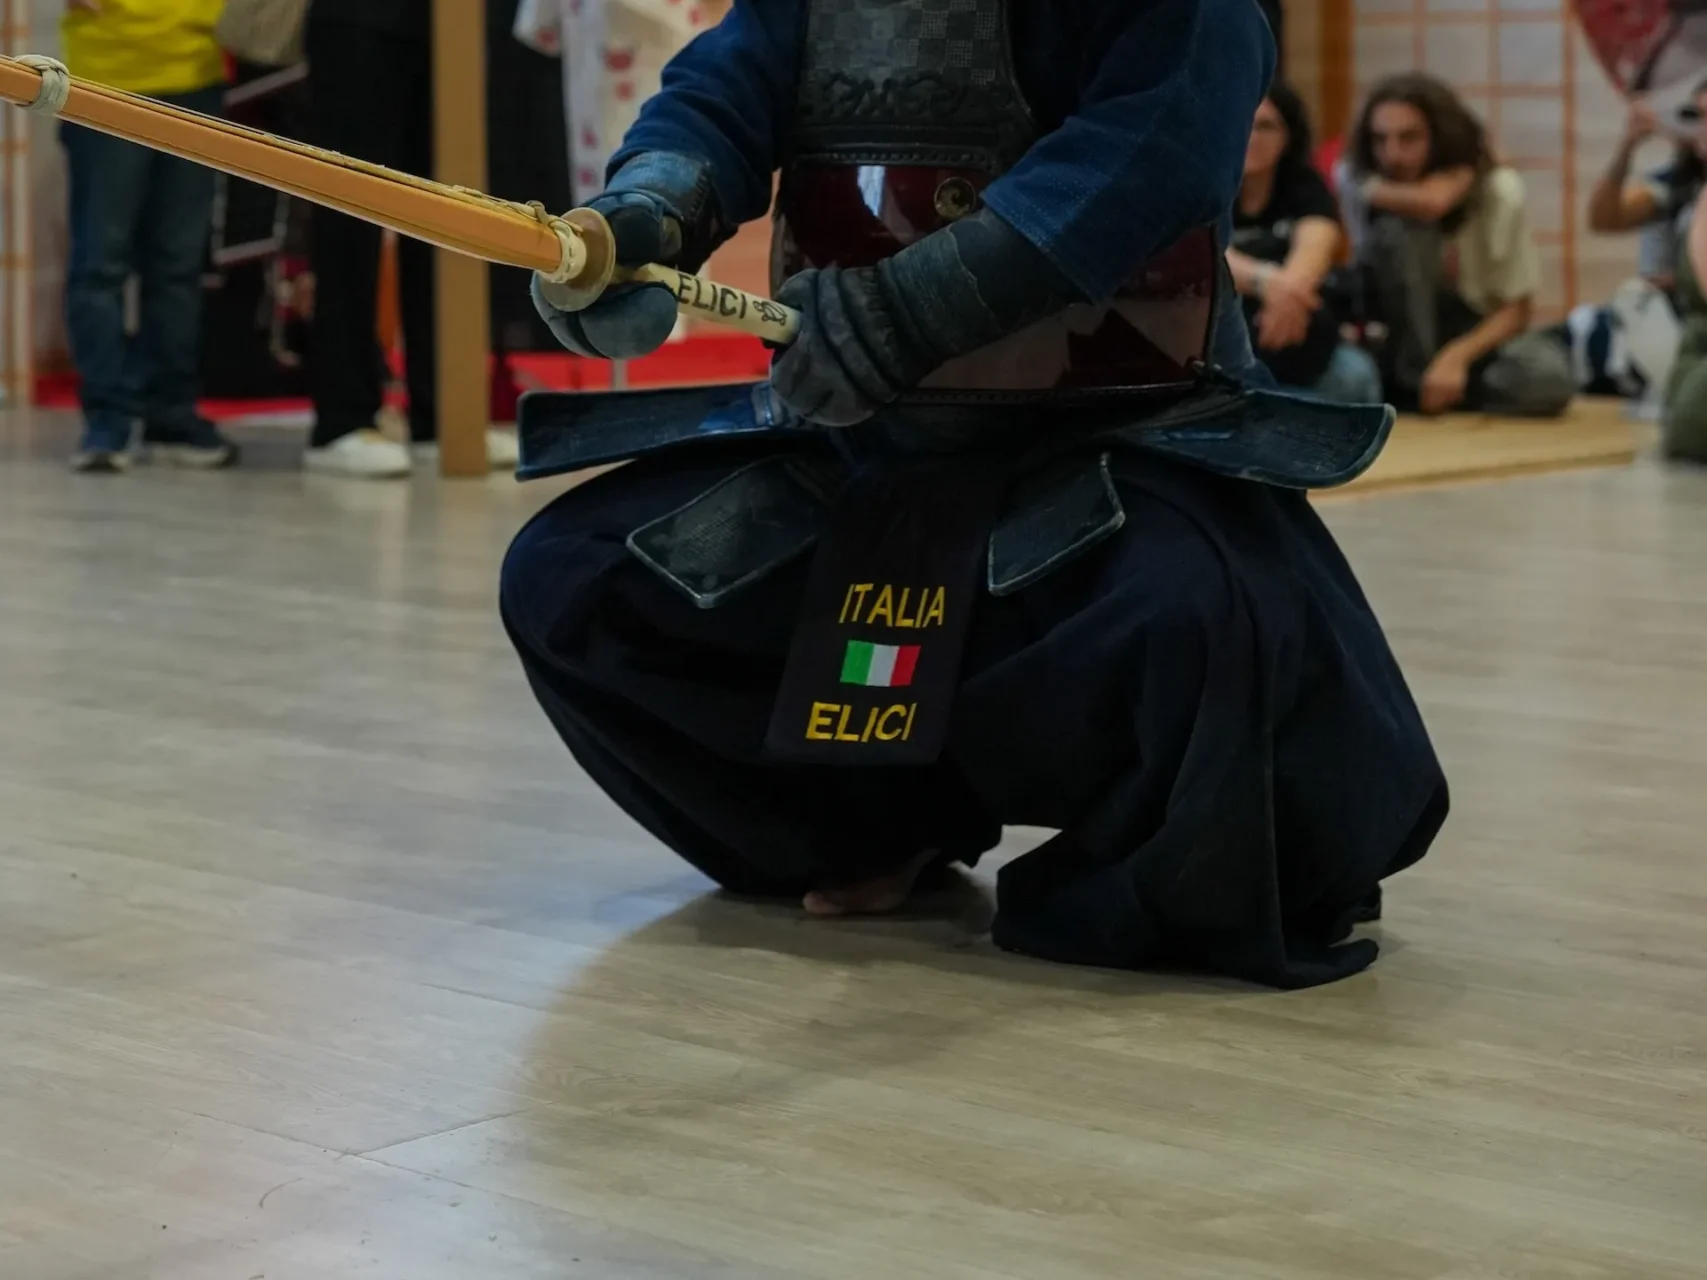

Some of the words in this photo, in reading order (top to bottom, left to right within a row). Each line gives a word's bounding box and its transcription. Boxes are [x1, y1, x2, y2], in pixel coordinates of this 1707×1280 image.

[677, 272, 748, 320] ELICI
[838, 582, 946, 629] ITALIA
[805, 701, 918, 743] ELICI
